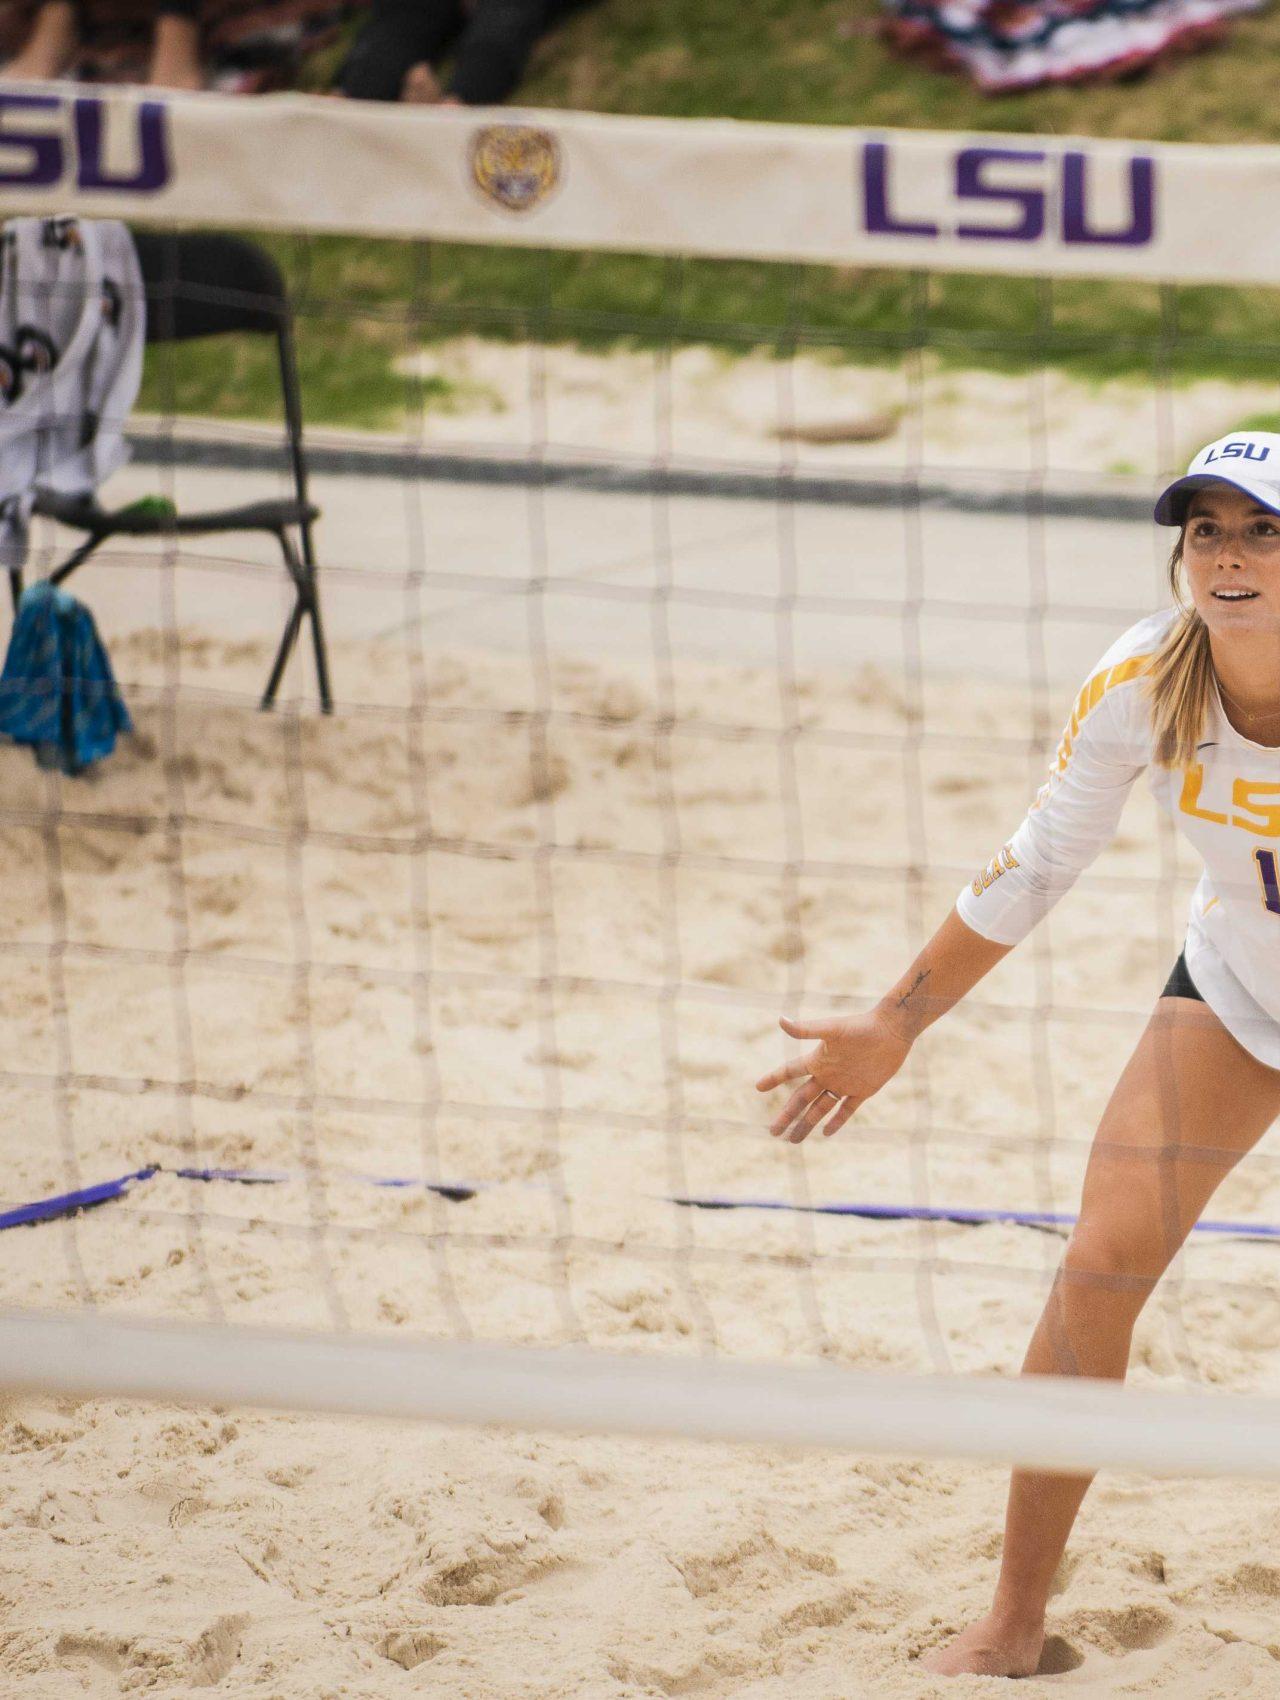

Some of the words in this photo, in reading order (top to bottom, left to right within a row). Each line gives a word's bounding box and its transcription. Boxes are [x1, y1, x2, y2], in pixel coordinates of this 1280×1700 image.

[0, 93, 172, 193] SU
[861, 141, 1156, 248] LSU
[1203, 442, 1271, 466] LSU
